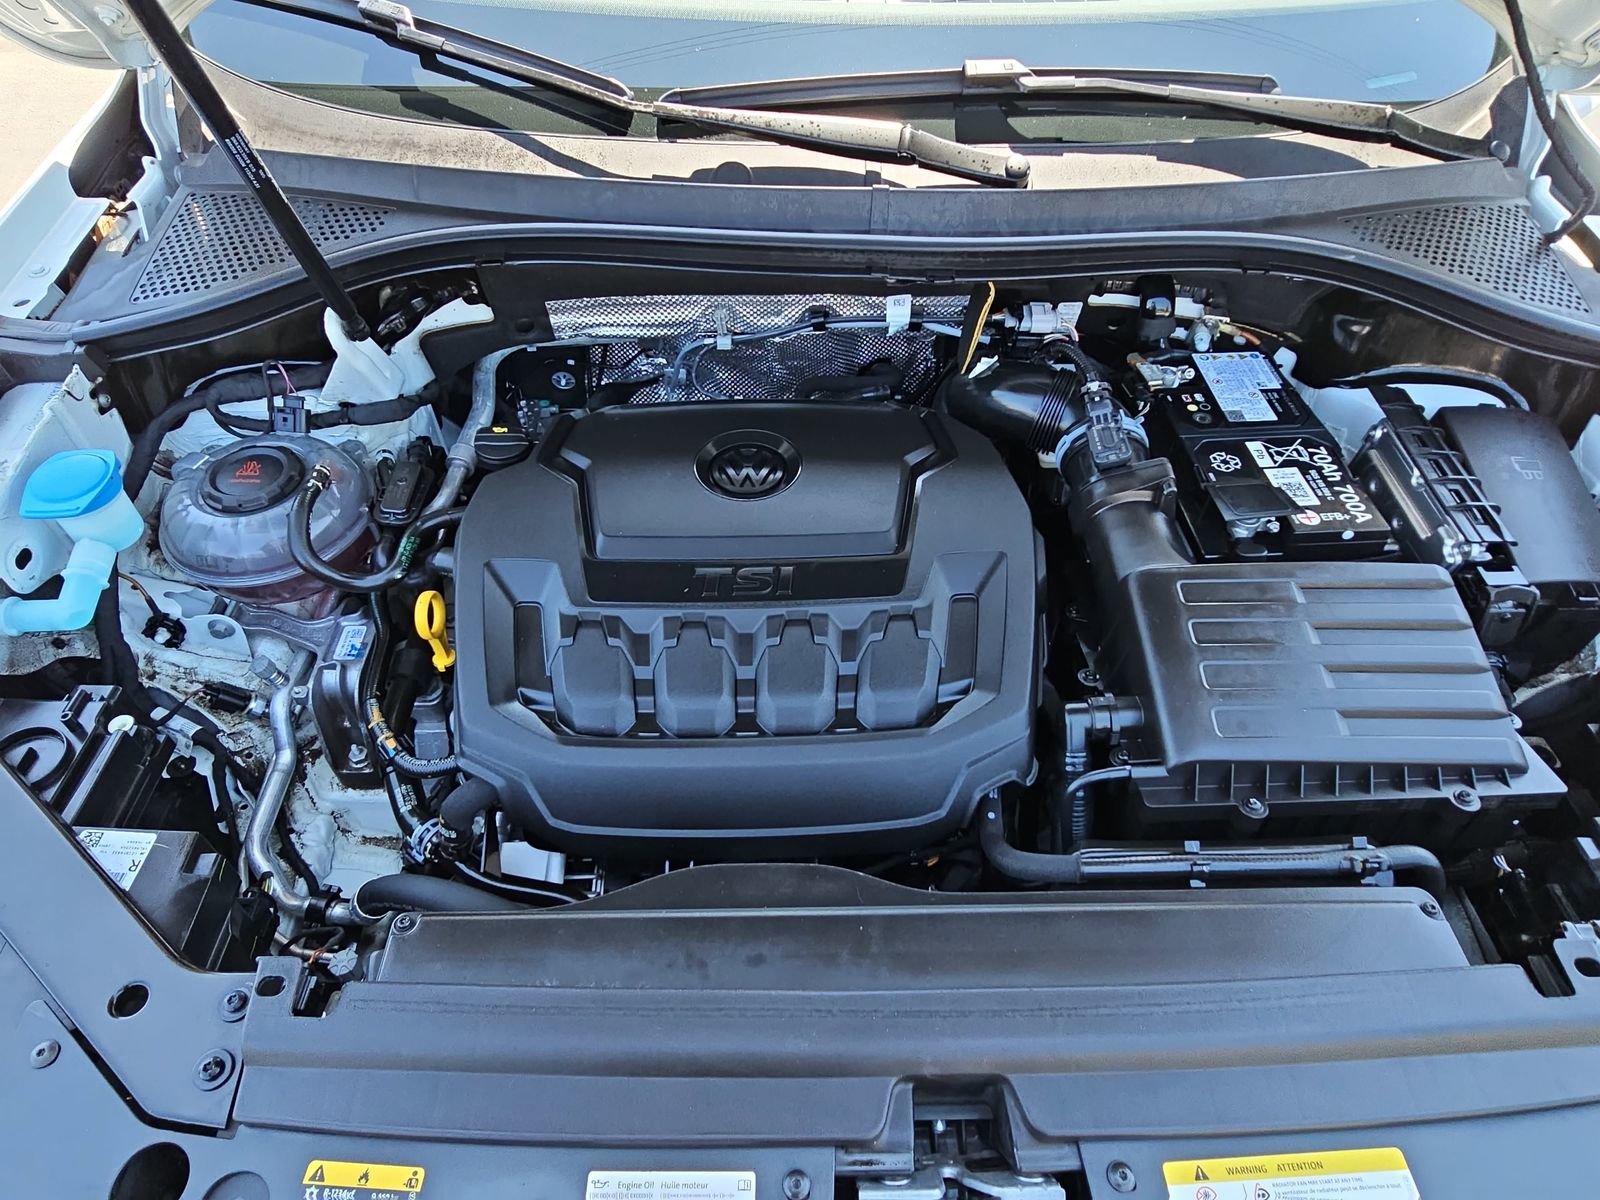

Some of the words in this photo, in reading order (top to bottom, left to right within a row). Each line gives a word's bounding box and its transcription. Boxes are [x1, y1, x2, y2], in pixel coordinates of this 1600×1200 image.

[1253, 449, 1264, 460] Pb
[1307, 446, 1343, 482] 70Ah
[1333, 484, 1373, 524] 700A
[693, 566, 795, 597] TSI
[128, 859, 142, 872] R
[1225, 1165, 1268, 1176] WARNING
[1276, 1161, 1324, 1173] ATTENTION
[617, 1180, 642, 1191] Engine
[643, 1180, 655, 1189] Oil
[660, 1180, 680, 1189] Huile
[681, 1180, 709, 1189] moteur
